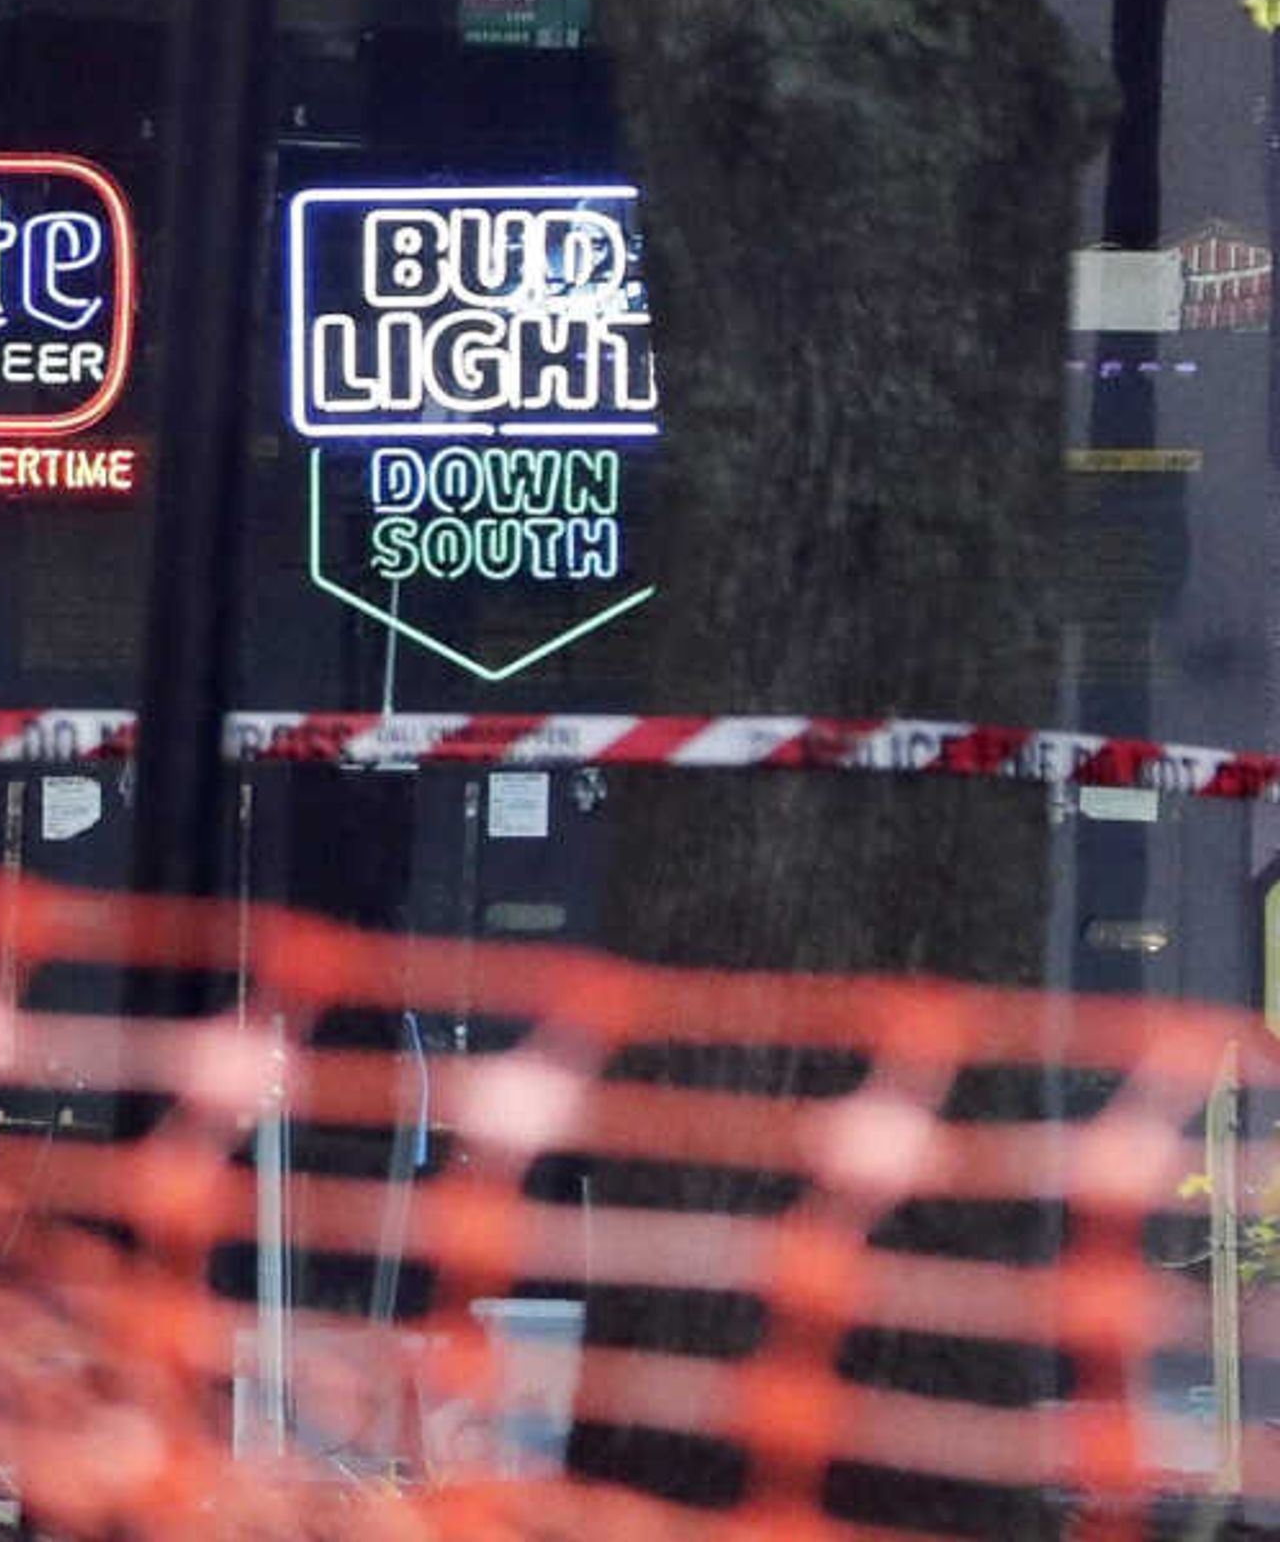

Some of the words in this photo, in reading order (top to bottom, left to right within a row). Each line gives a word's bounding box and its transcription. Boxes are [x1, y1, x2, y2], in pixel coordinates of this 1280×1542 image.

[364, 208, 628, 310] BUD
[313, 311, 660, 413] LIGHT
[370, 447, 620, 516] DOWN
[370, 517, 618, 580] SOUTH
